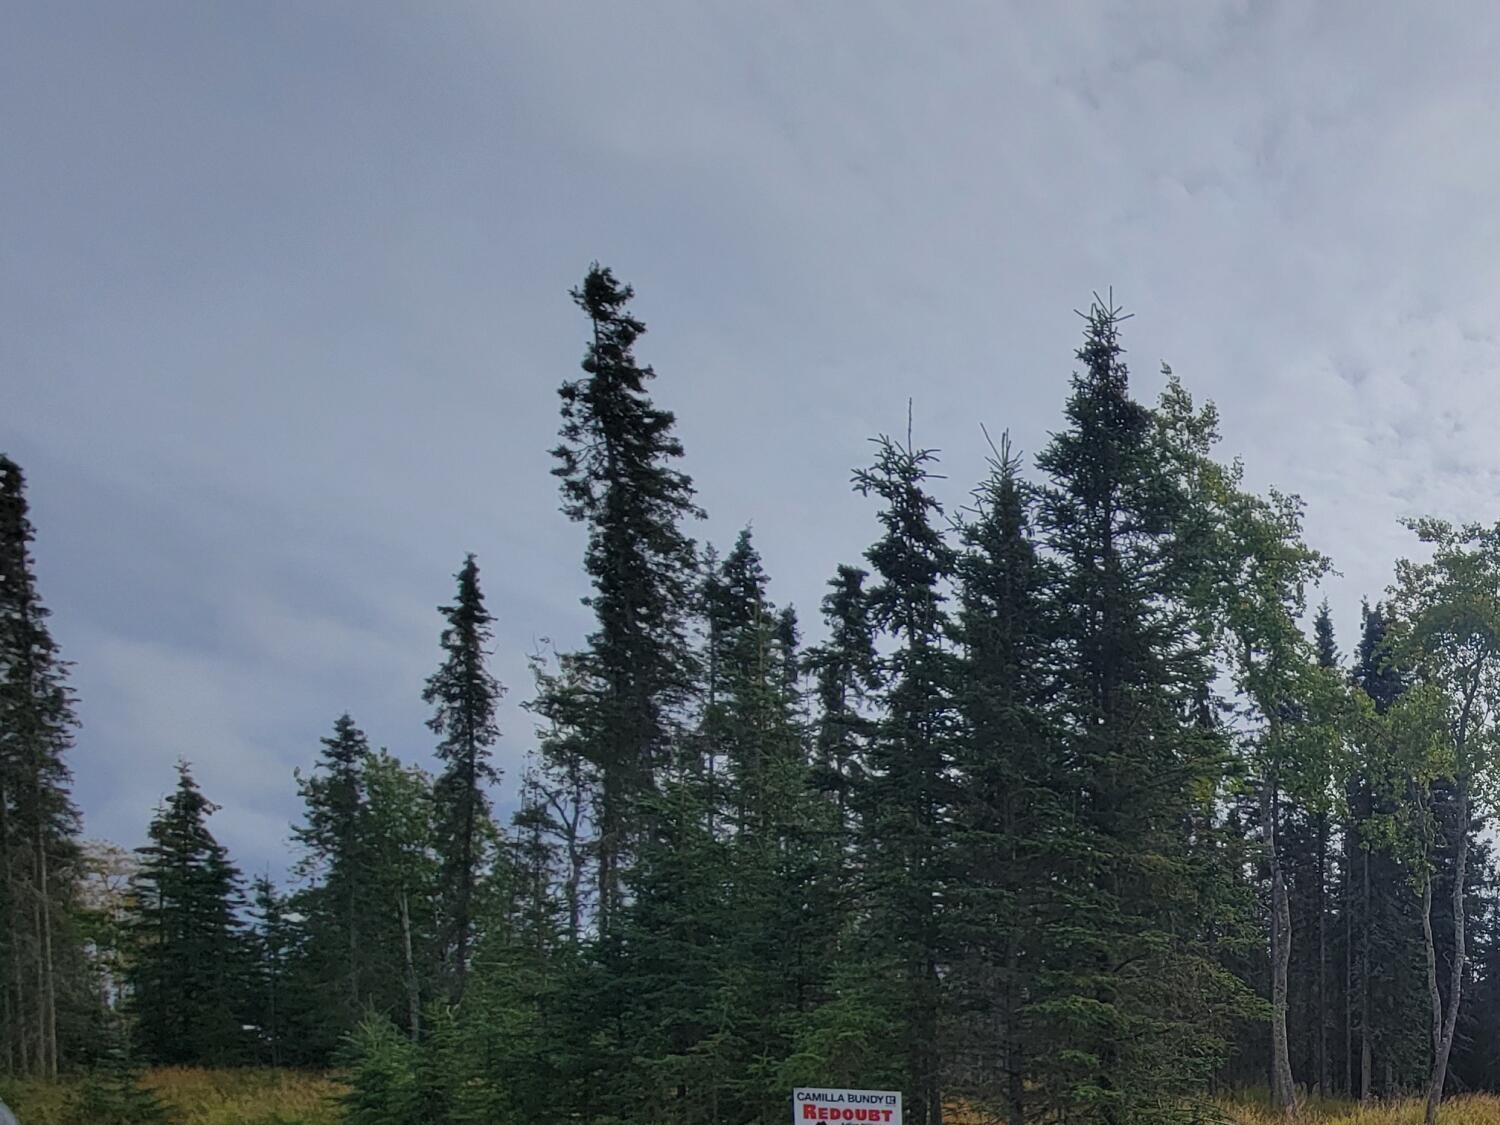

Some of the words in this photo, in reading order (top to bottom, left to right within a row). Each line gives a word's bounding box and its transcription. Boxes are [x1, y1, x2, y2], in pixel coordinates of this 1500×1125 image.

[797, 1092, 845, 1103] CAMILLA
[848, 1093, 884, 1104] BUNDY
[803, 1104, 893, 1122] REDOUBT
